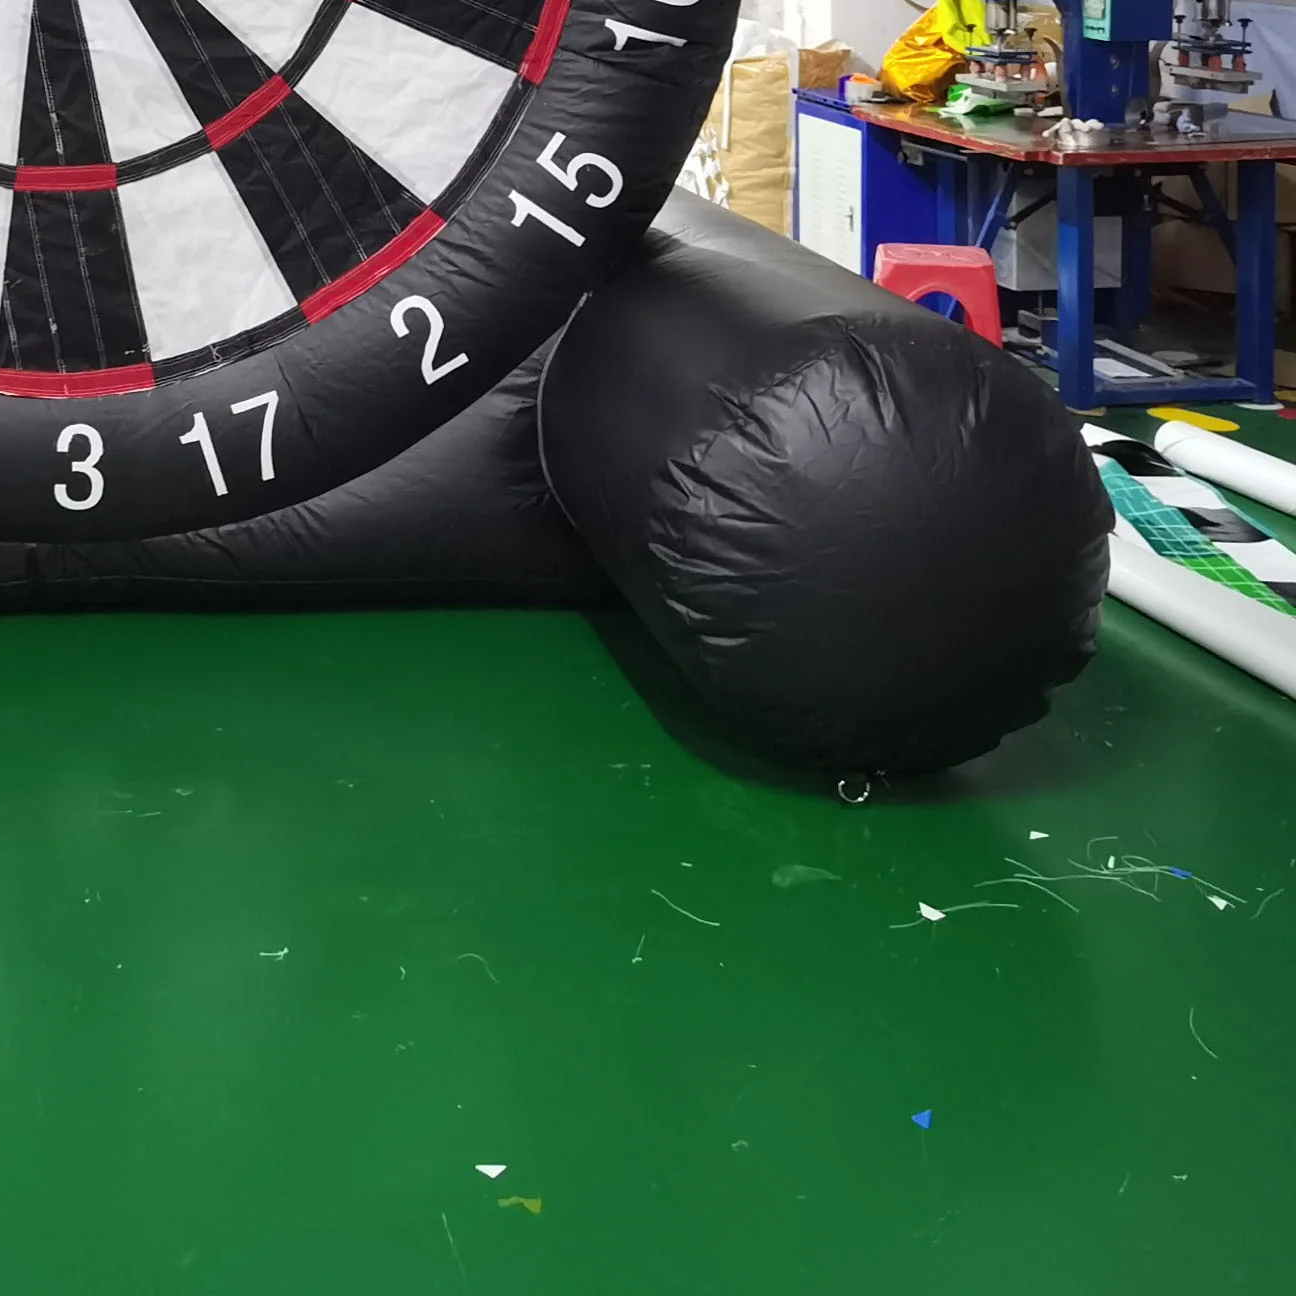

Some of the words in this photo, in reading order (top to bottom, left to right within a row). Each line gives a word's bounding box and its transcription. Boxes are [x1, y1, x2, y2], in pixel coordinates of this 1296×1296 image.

[507, 131, 623, 247] 15
[389, 294, 469, 385] 2
[54, 423, 104, 511] 3
[178, 389, 279, 496] 17
